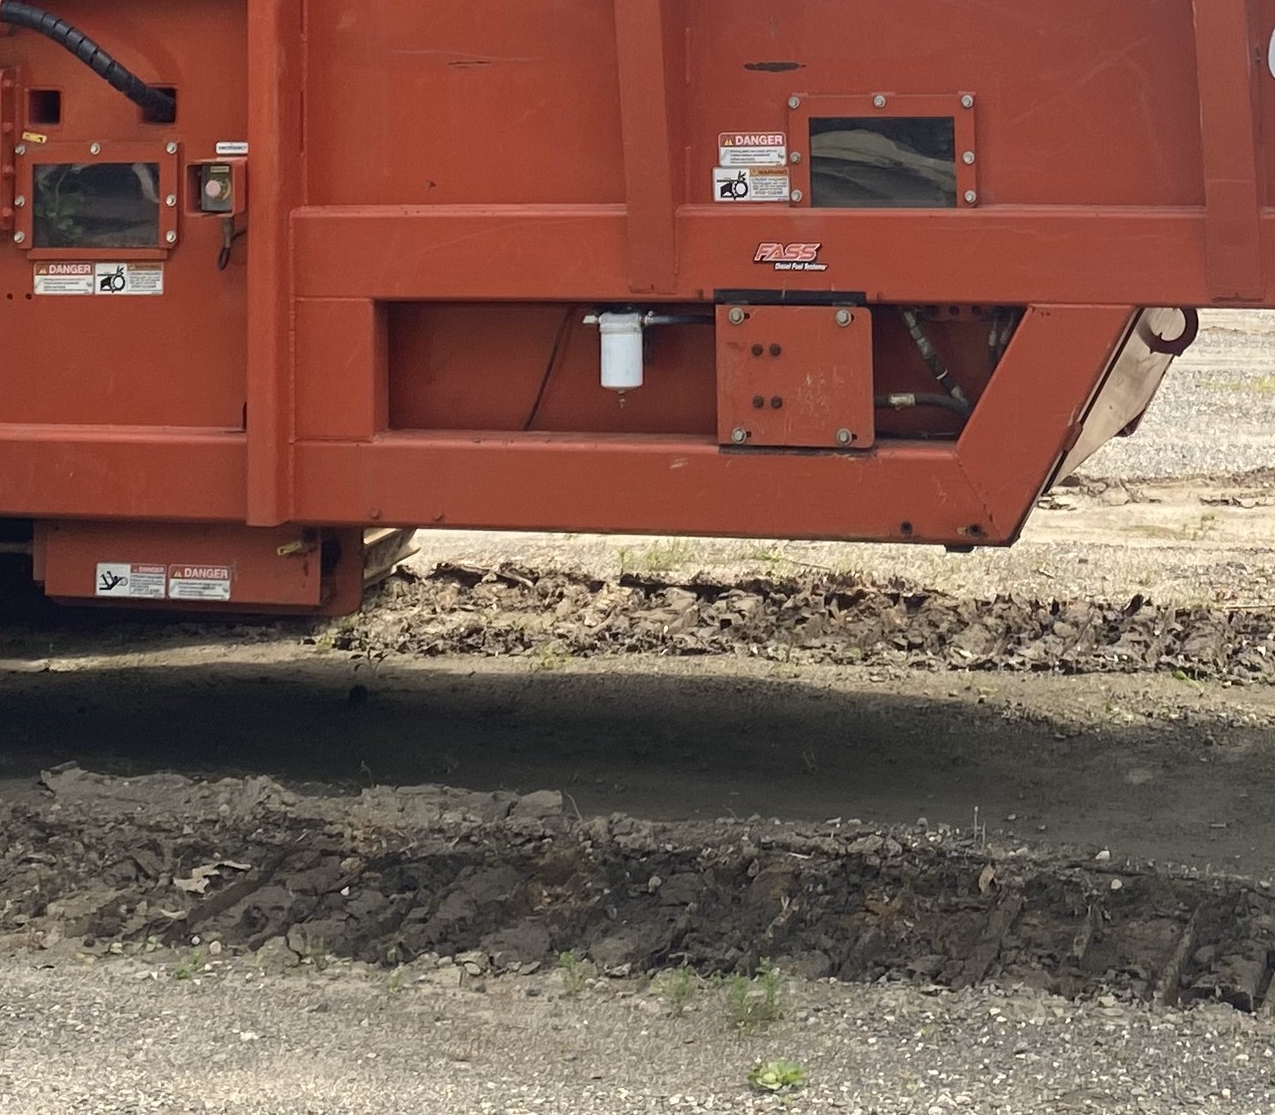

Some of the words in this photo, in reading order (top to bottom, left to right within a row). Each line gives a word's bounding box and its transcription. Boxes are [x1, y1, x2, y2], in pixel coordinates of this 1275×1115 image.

[735, 135, 783, 146] DANGER
[754, 243, 821, 261] FASS
[48, 264, 92, 274] DANGER
[184, 567, 228, 579] DANGER
